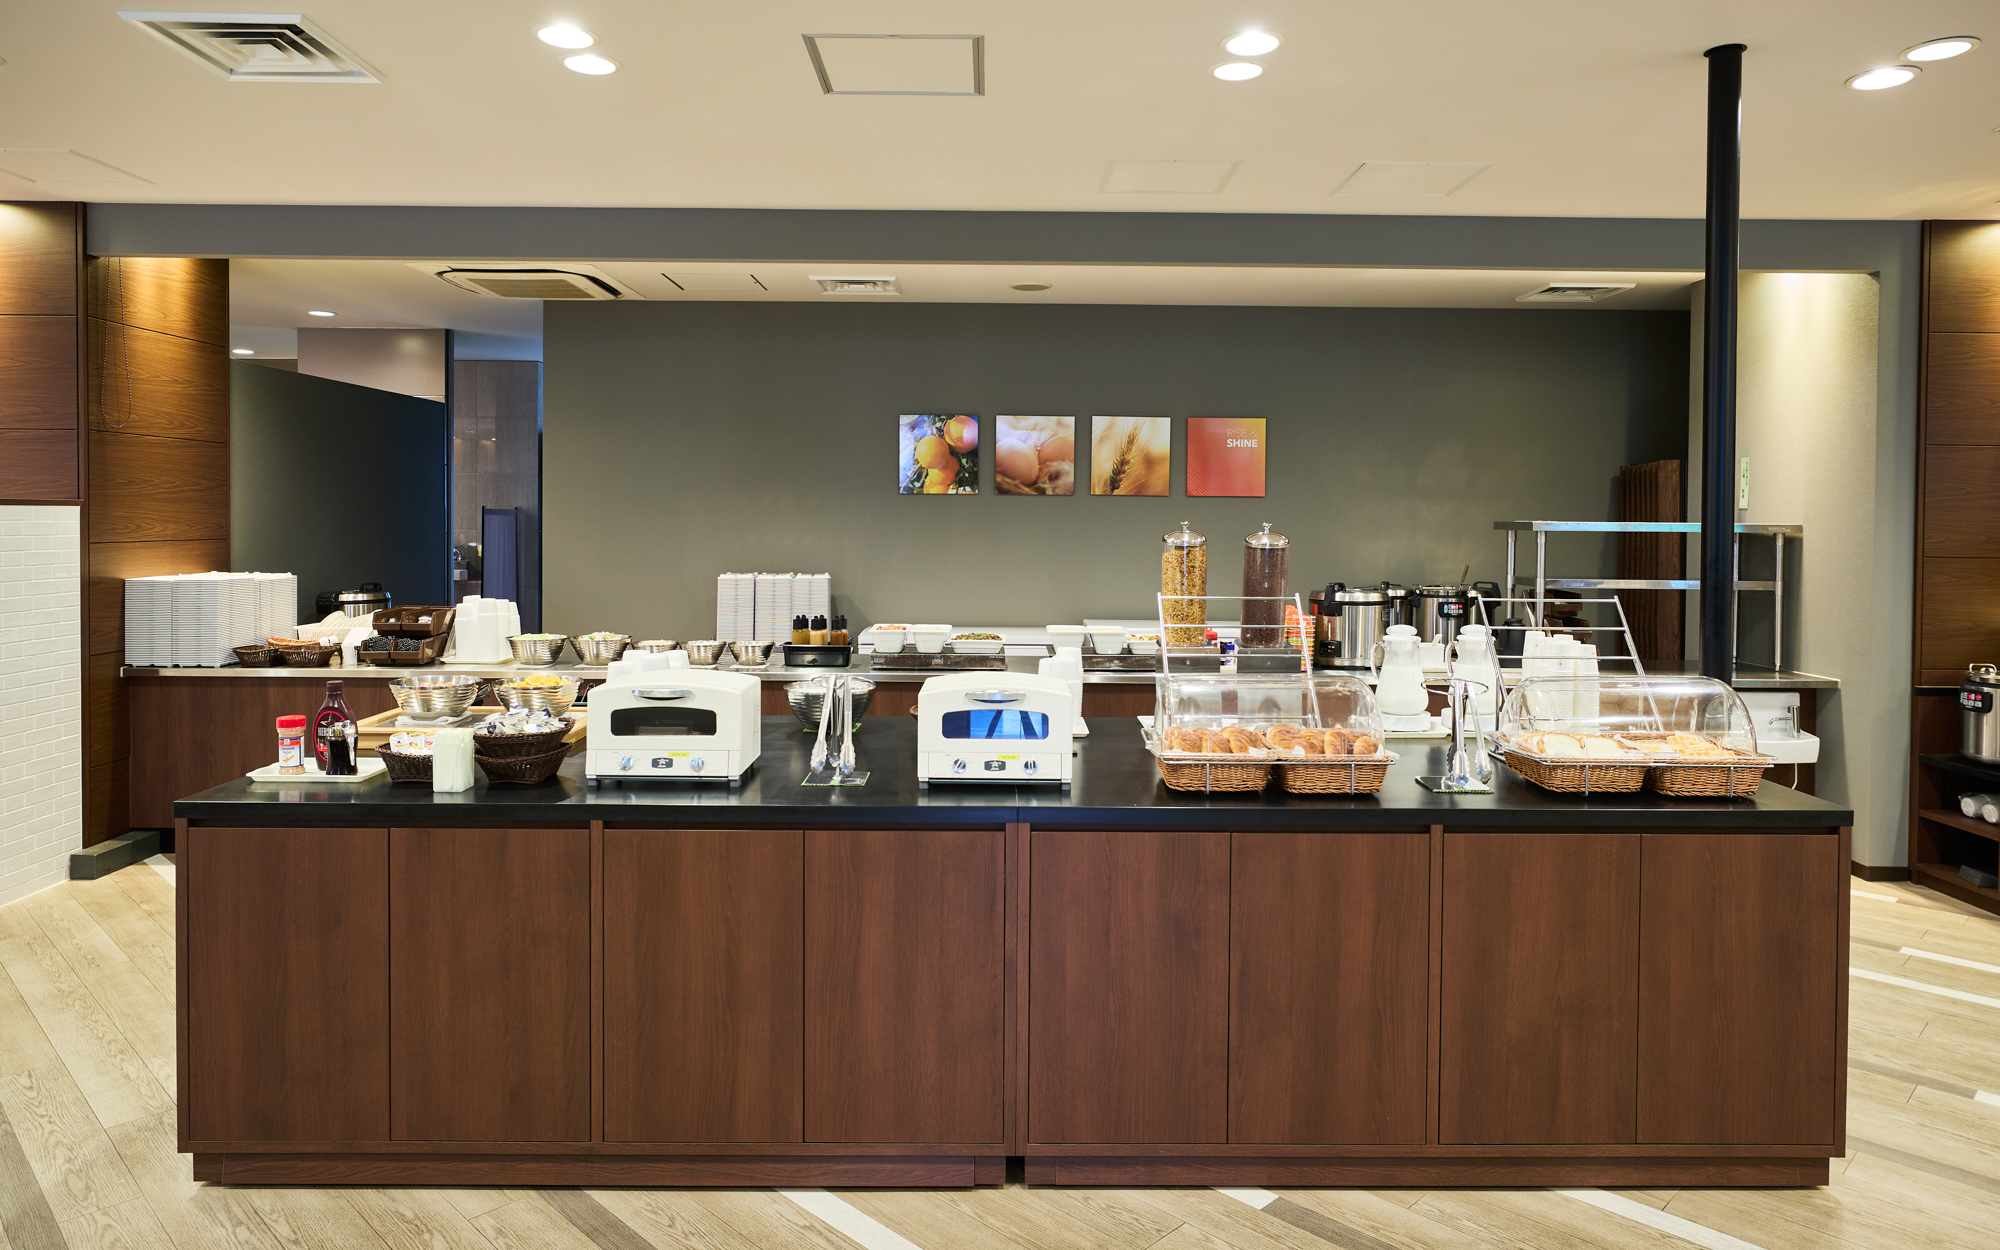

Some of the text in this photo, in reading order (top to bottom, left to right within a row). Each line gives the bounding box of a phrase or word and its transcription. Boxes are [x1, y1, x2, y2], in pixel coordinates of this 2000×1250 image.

[1227, 428, 1258, 438] RISE &
[1226, 438, 1258, 448] SHINE
